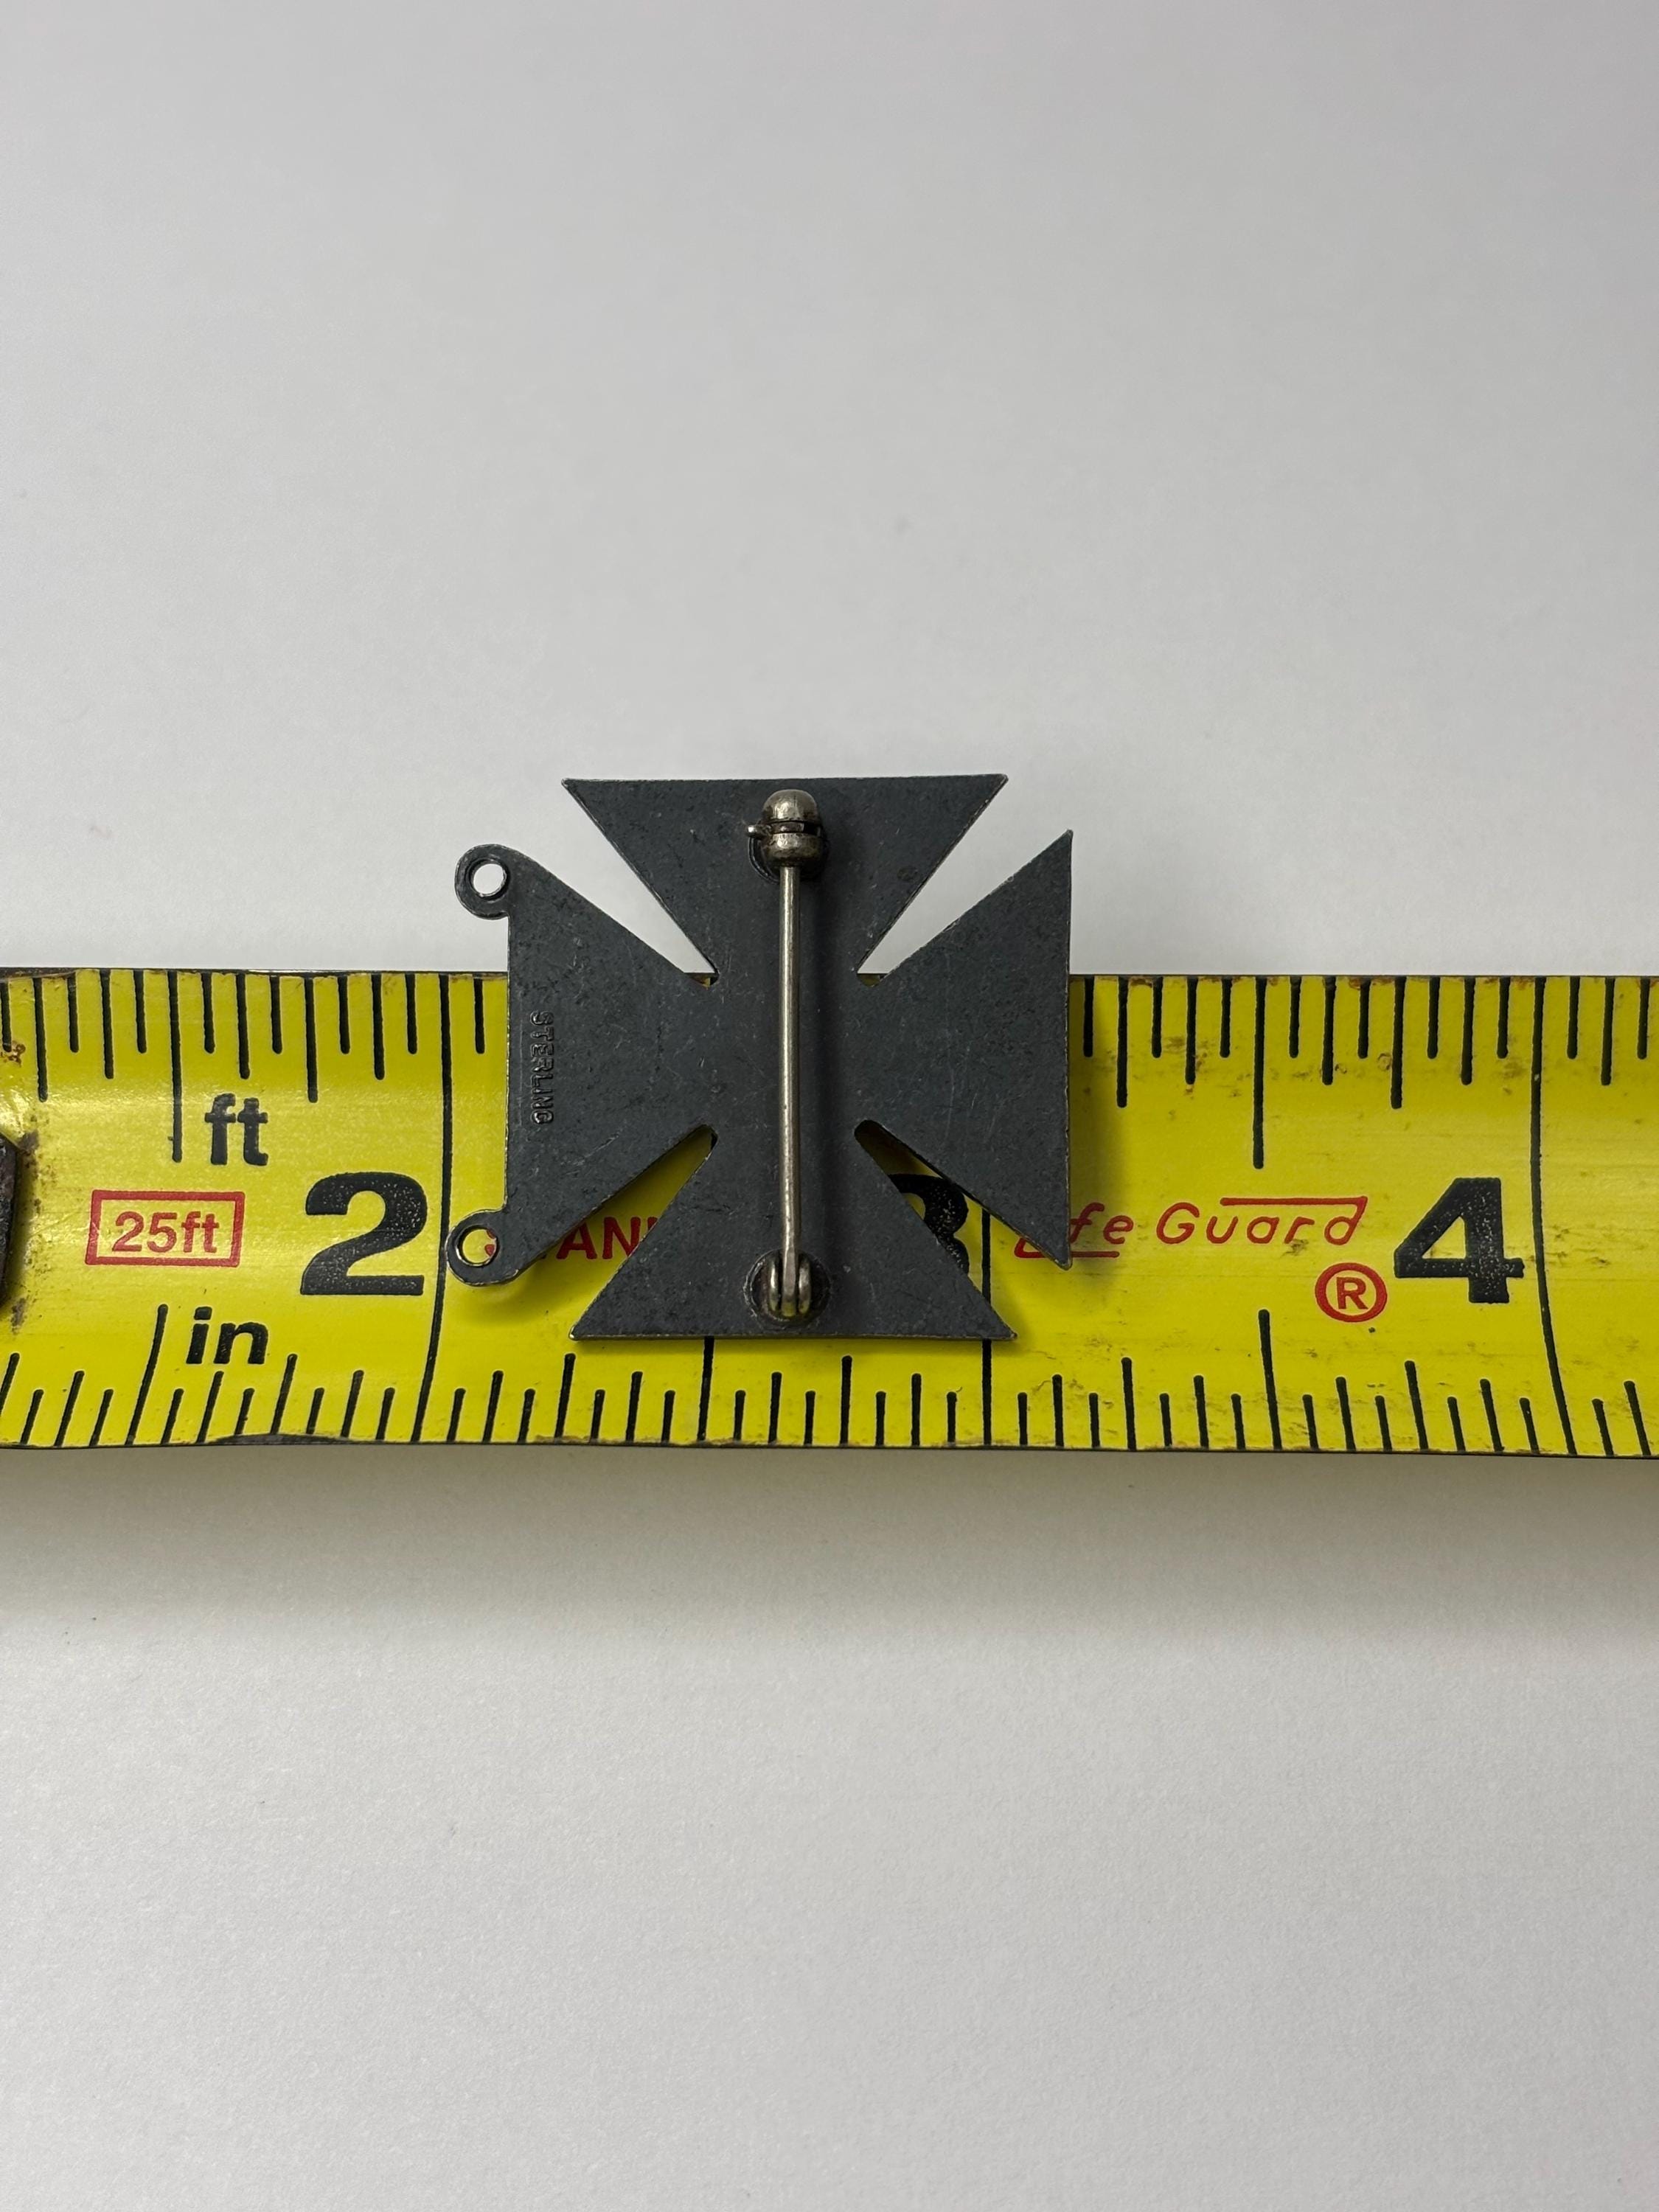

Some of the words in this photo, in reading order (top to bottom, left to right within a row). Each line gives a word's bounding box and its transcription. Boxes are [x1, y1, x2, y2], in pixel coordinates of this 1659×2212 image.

[530, 1009, 554, 1125] STERLING
[204, 1093, 269, 1166] ft
[112, 1211, 219, 1254] 25ft
[299, 1172, 428, 1296] 2
[1155, 1195, 1369, 1246] Guard
[1394, 1177, 1526, 1304] 4
[185, 1306, 269, 1365] in
